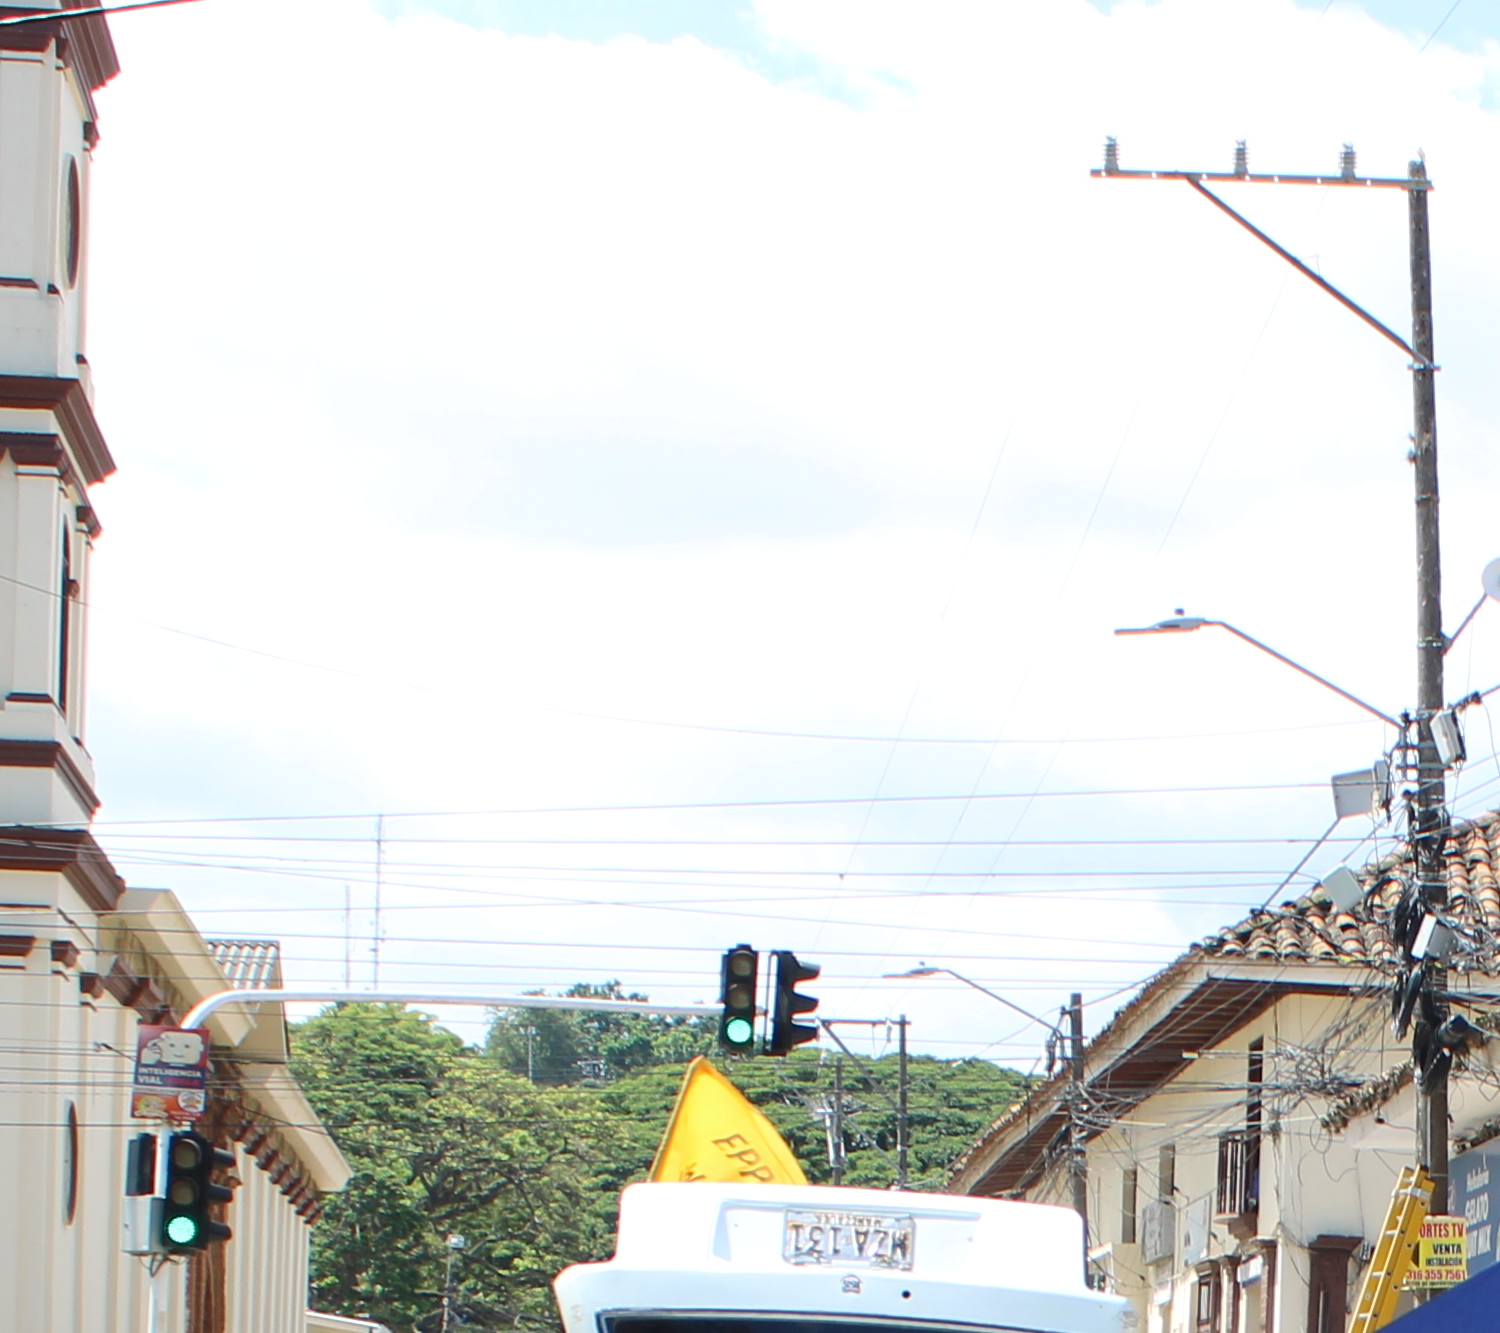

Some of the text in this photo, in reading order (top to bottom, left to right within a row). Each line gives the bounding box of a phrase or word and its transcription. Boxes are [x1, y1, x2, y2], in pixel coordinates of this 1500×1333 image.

[1419, 1222, 1465, 1239] ORTES TV
[1432, 1243, 1462, 1255] VENTA
